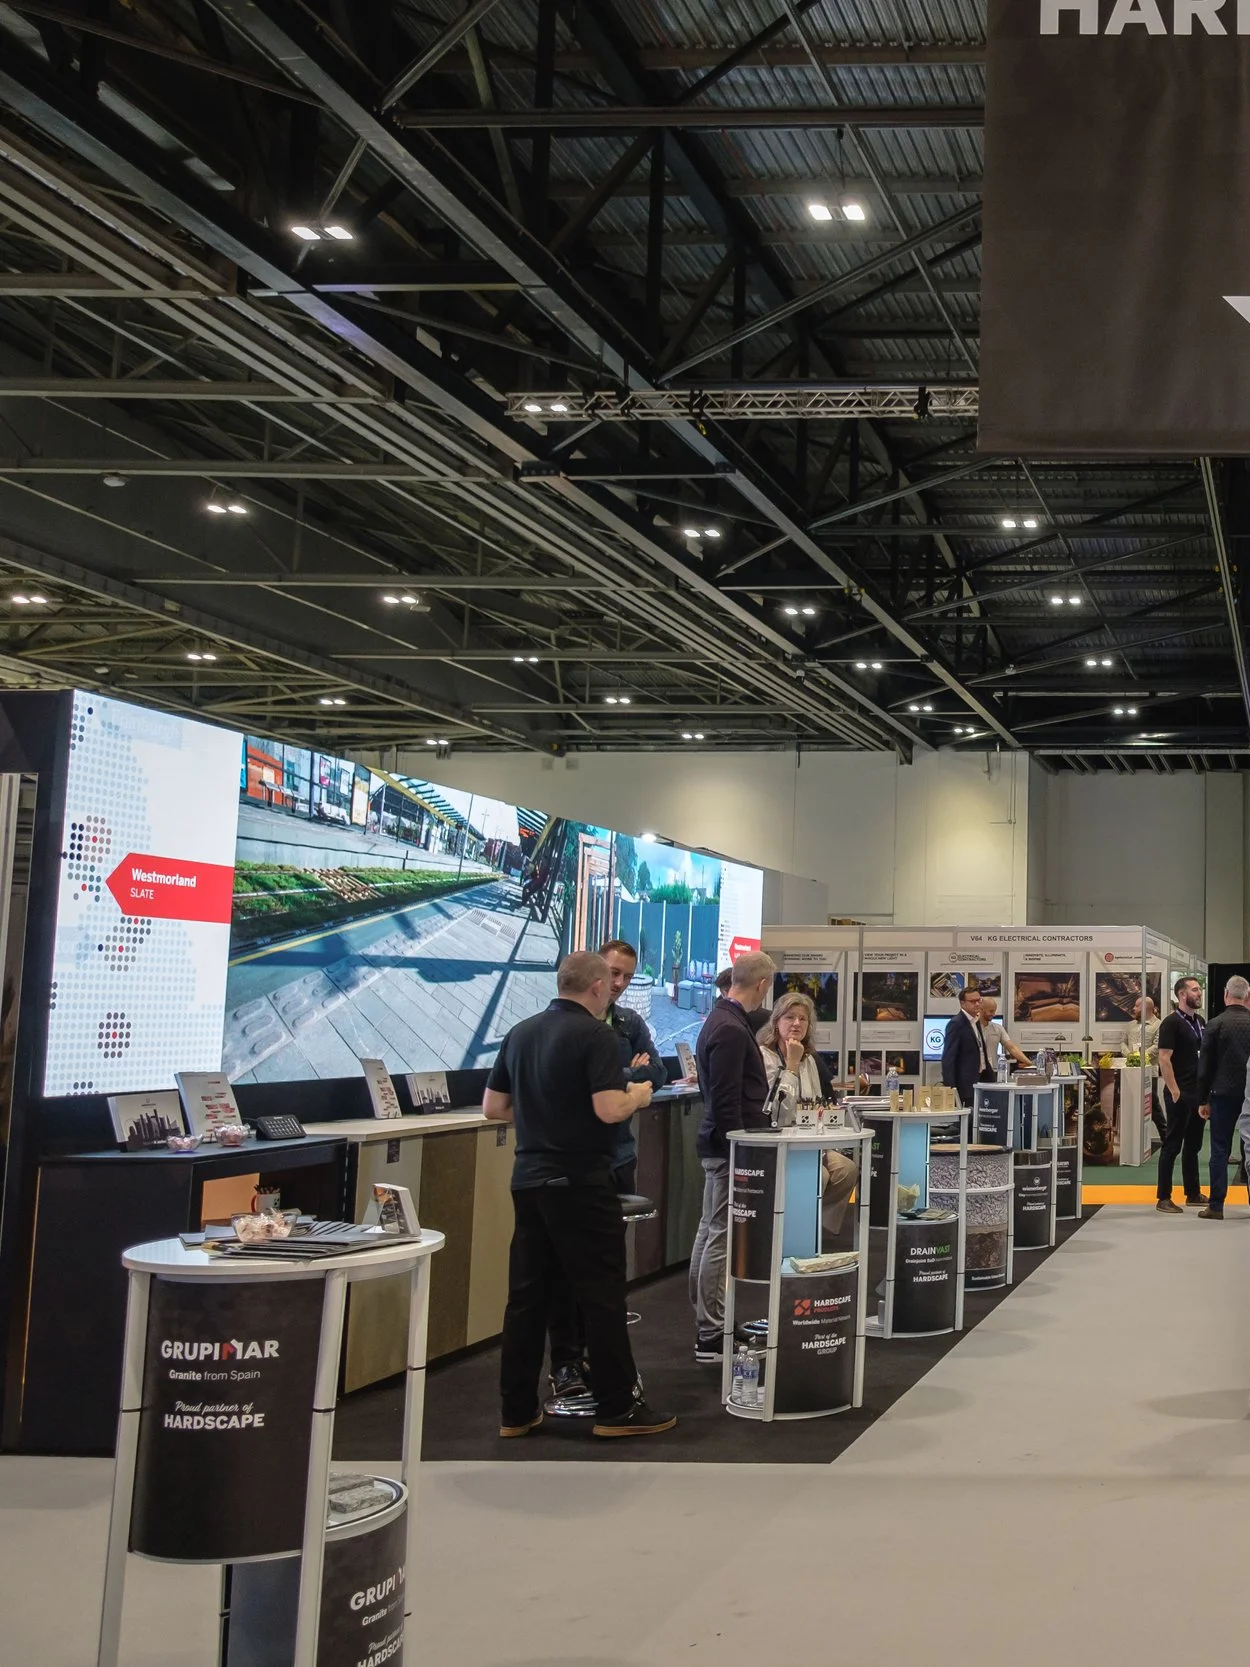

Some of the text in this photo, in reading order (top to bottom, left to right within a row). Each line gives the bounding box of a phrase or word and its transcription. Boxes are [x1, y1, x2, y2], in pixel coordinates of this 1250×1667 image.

[132, 868, 197, 888] Westmorland
[130, 888, 154, 900] SLATE
[911, 1245, 951, 1256] DRAINVAST
[913, 1274, 949, 1283] HARDSCAPE
[814, 1295, 852, 1307] HARDSCAPE
[161, 1339, 280, 1360] GRUPIMAR
[802, 1337, 847, 1350] HARDSCAPE
[169, 1369, 261, 1382] Granite from Spain
[175, 1401, 254, 1416] Proud partner of
[164, 1413, 265, 1430] HARDSCAPE
[362, 1608, 388, 1626] Granite
